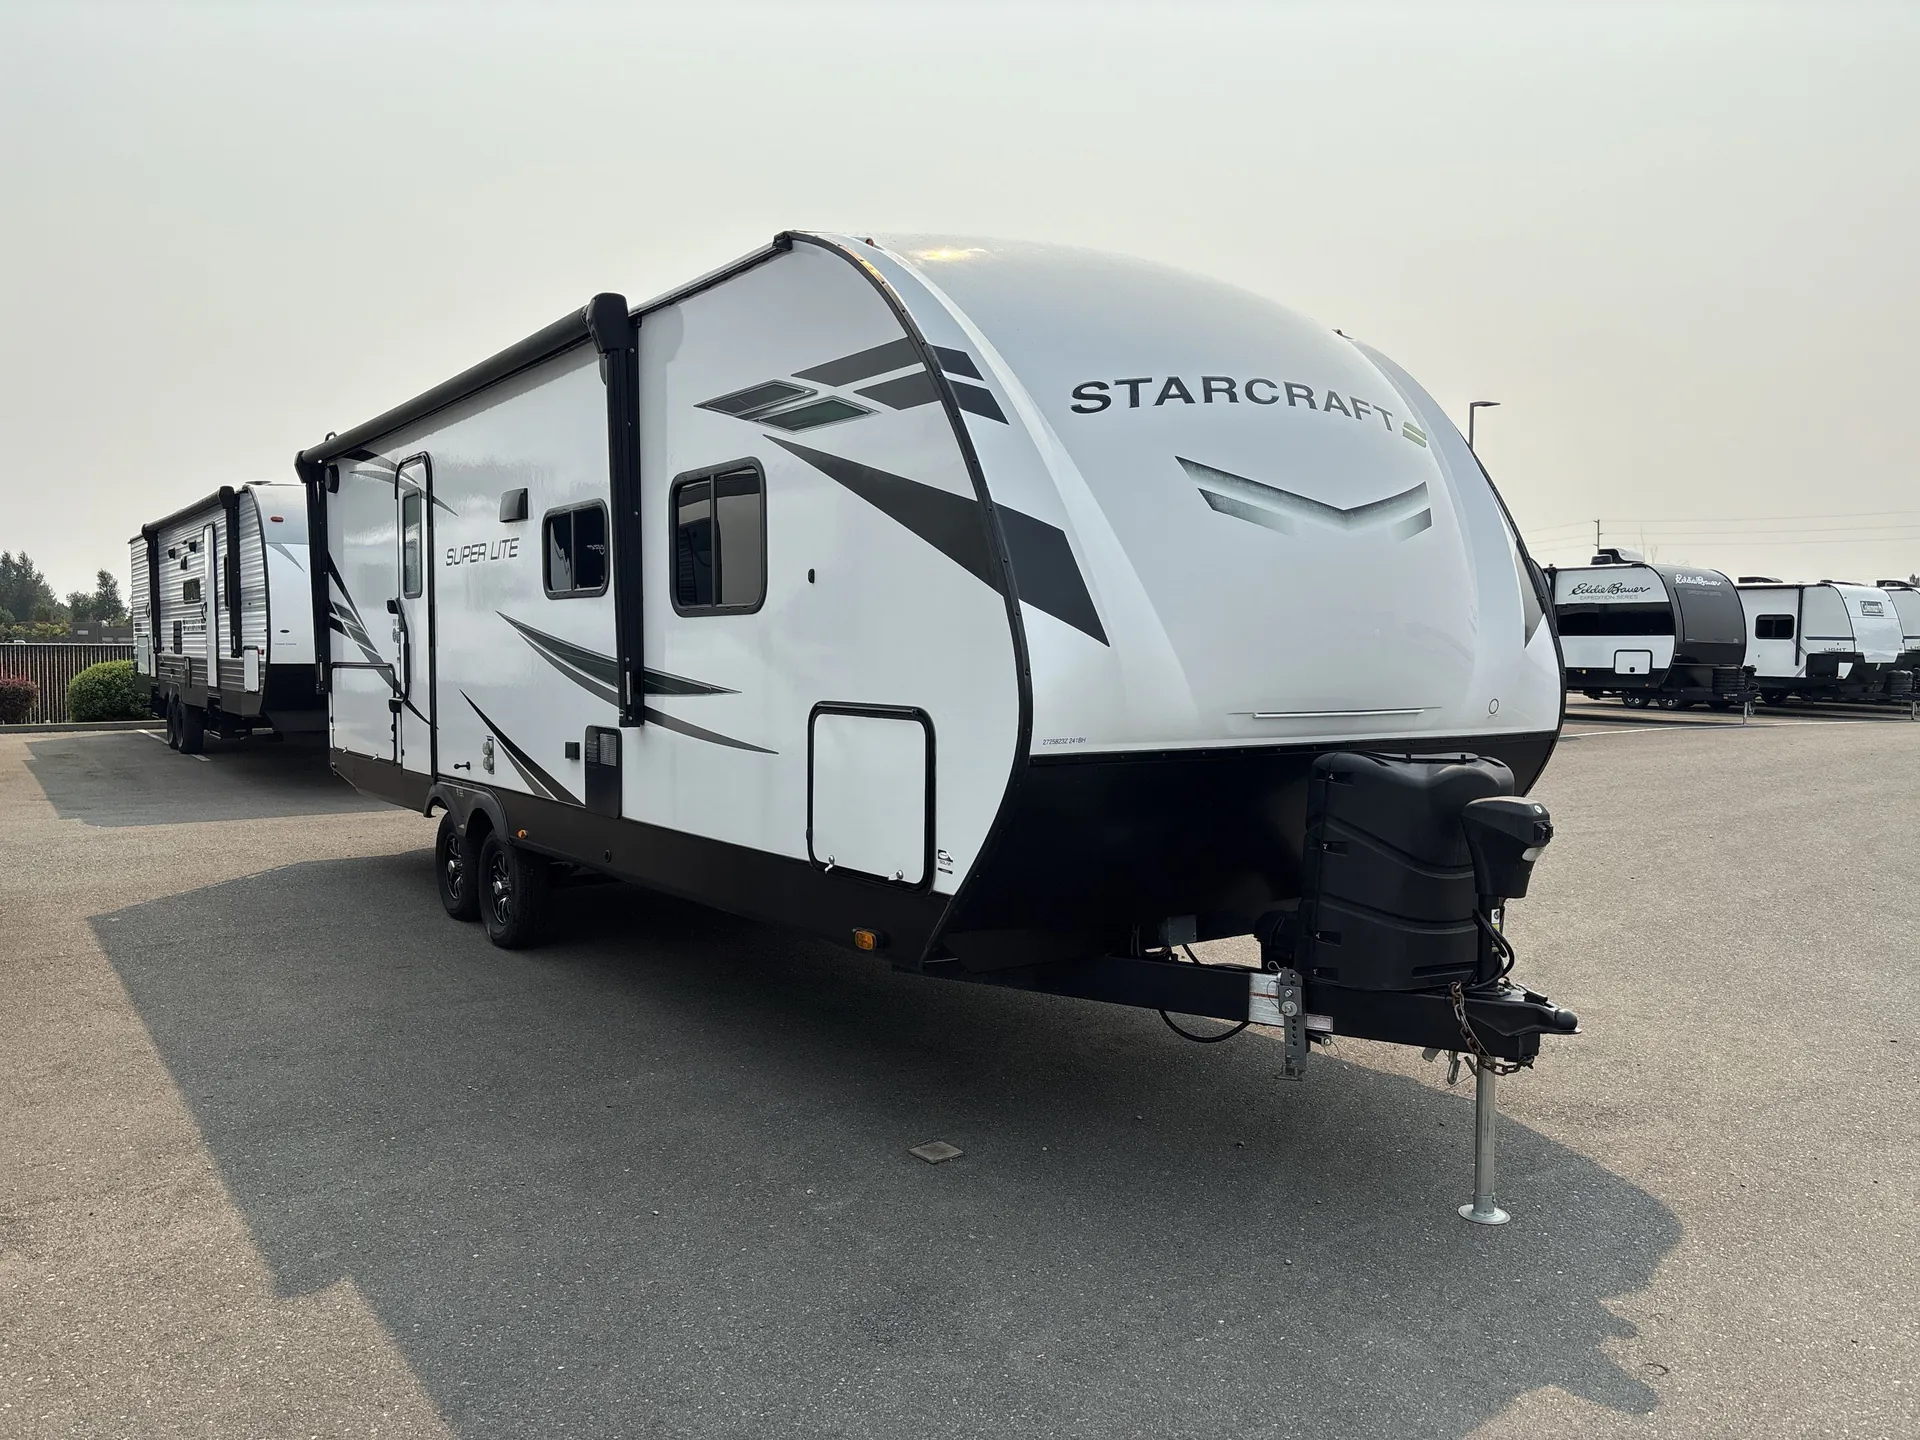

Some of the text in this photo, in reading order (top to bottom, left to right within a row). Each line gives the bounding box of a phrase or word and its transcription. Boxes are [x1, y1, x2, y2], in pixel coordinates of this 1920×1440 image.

[1070, 375, 1394, 432] STARCRAFT
[445, 537, 520, 567] SUPER LITE
[1568, 582, 1651, 597] Eddie Bauer
